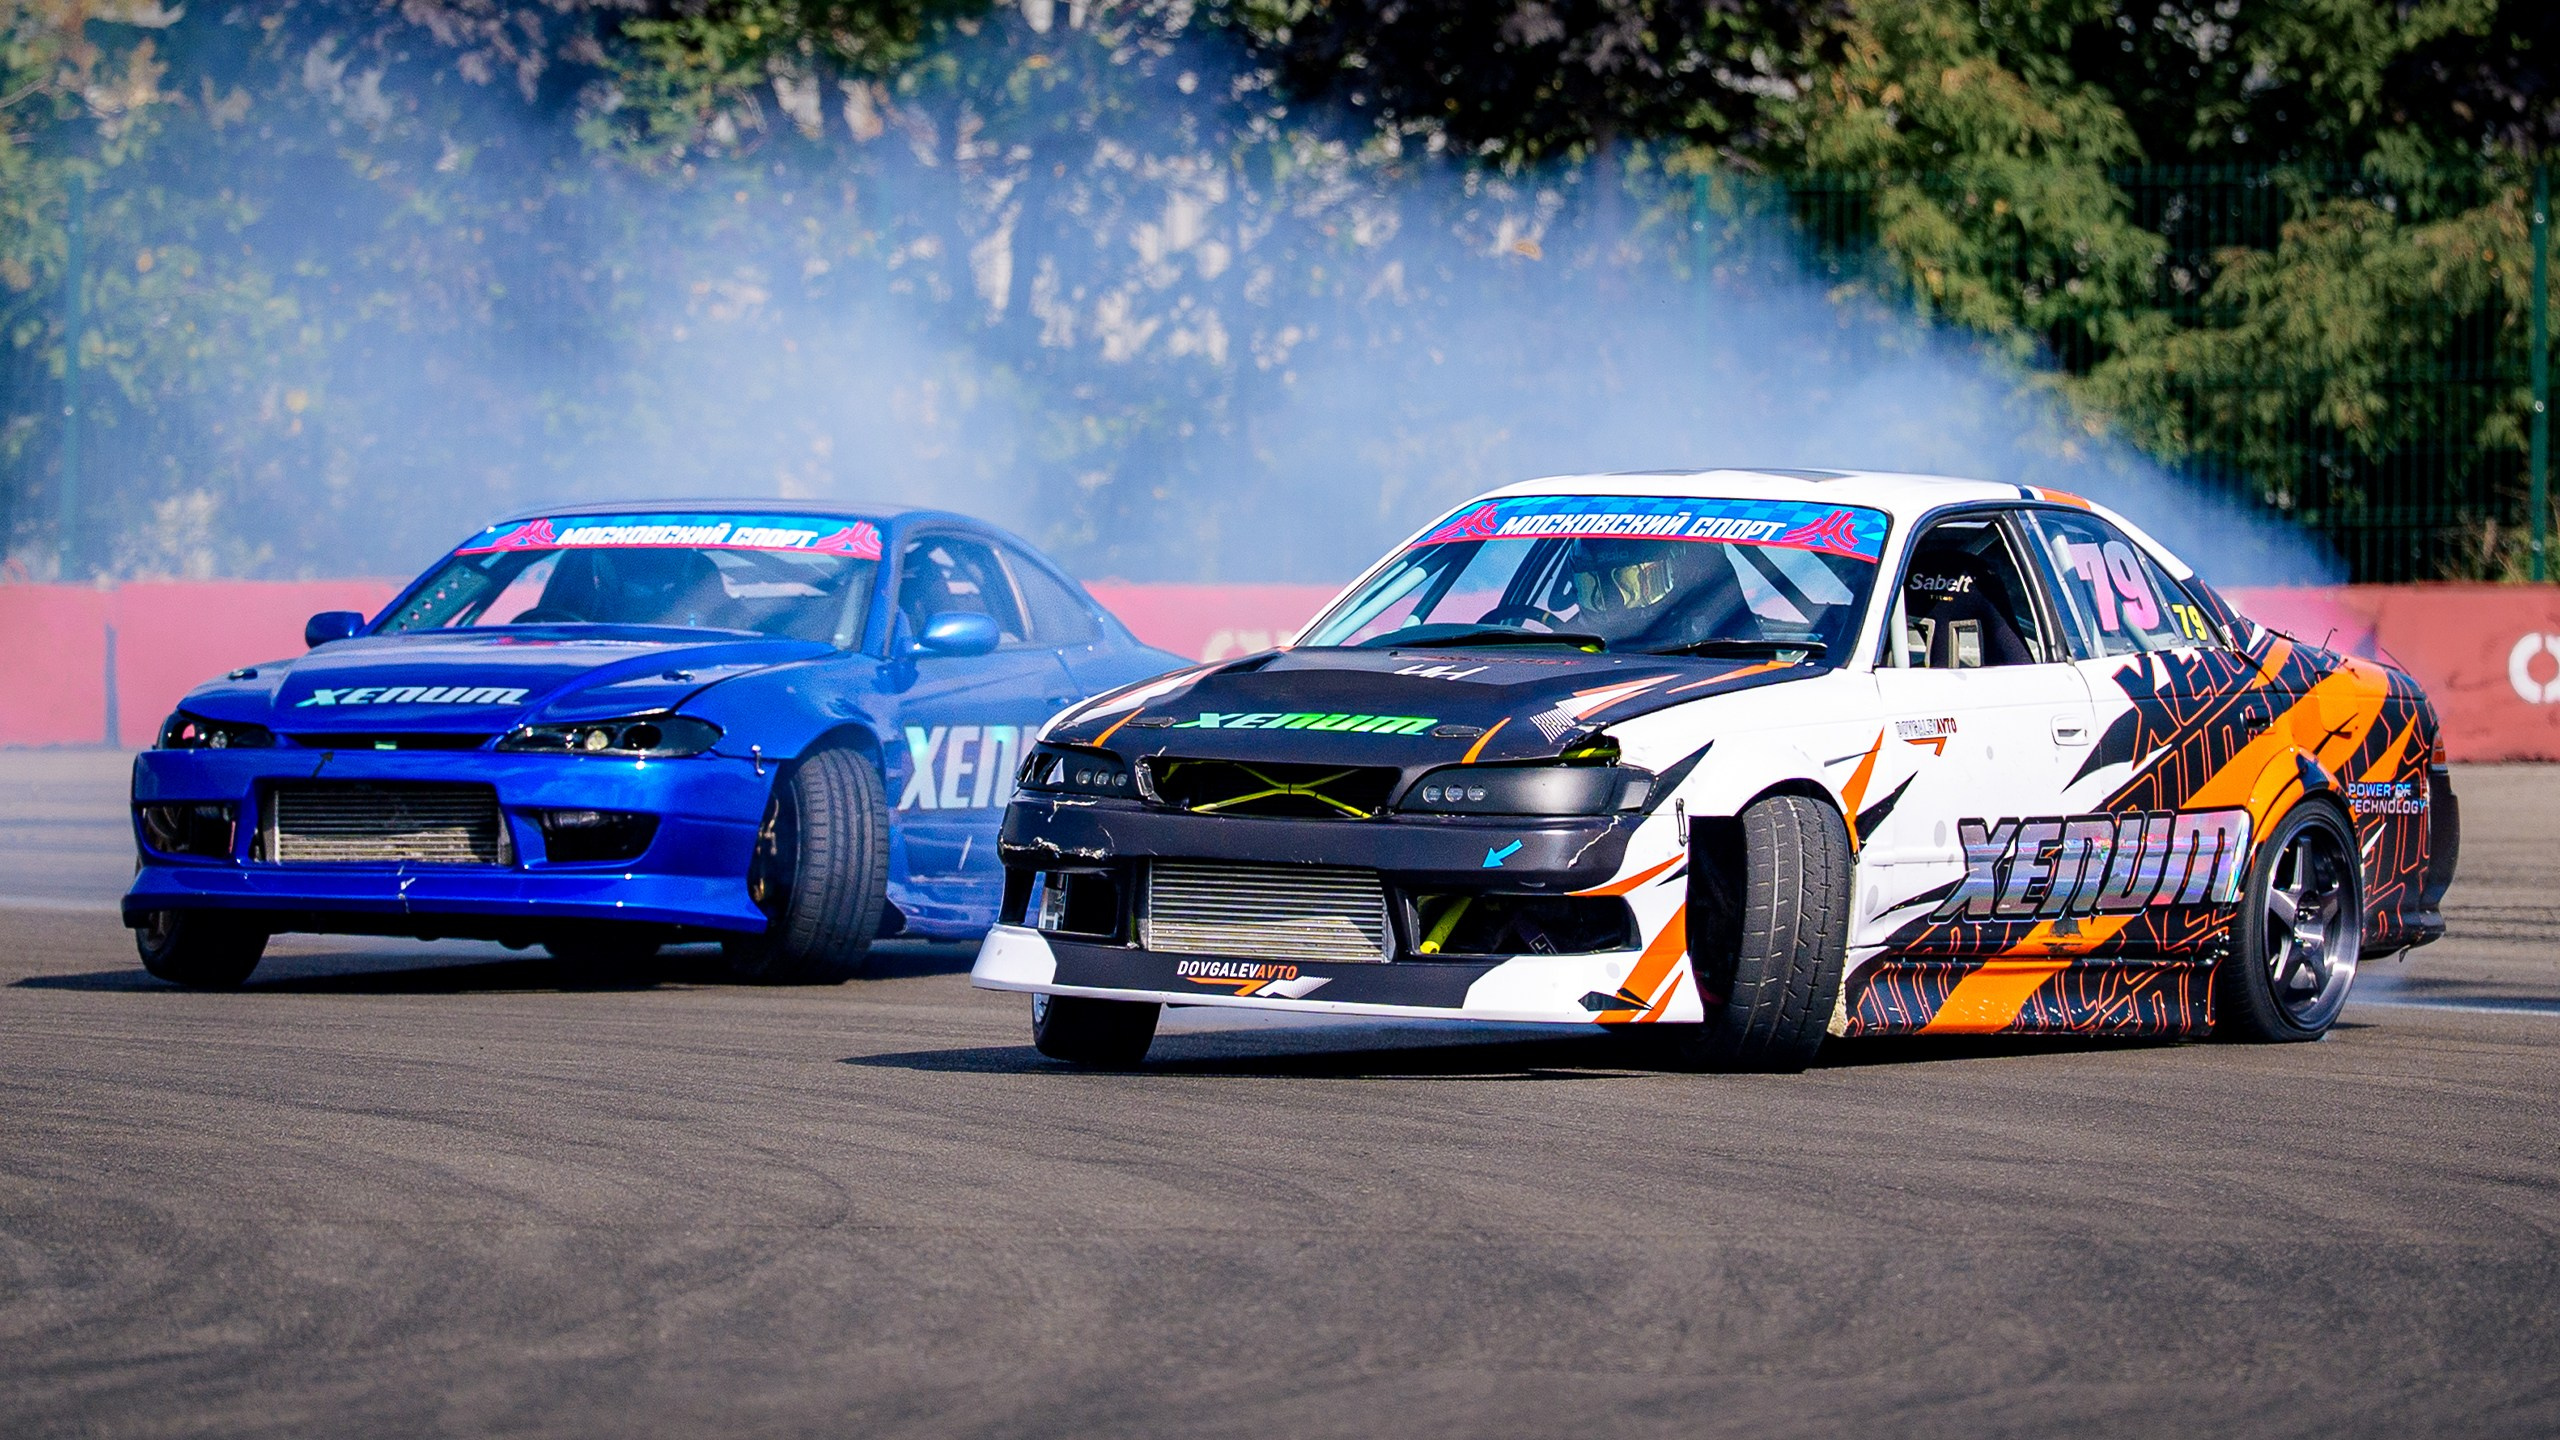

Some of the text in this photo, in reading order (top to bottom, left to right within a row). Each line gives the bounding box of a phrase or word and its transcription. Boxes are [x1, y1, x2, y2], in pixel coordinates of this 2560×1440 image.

[556, 522, 819, 548] МОСКОВСКИЙ СПОРТ
[1496, 511, 1787, 541] МОСКОВСКИЙ СПОРТ
[1910, 573, 1973, 592] Sabelt
[2069, 541, 2160, 631] 79
[2171, 604, 2208, 641] 79
[295, 687, 529, 708] XENUM
[1174, 712, 1438, 736] XENUM
[2348, 783, 2411, 798] POWER OF
[1928, 805, 2255, 924] XENUM
[1177, 961, 1298, 980] DOVGALEVAVTO
